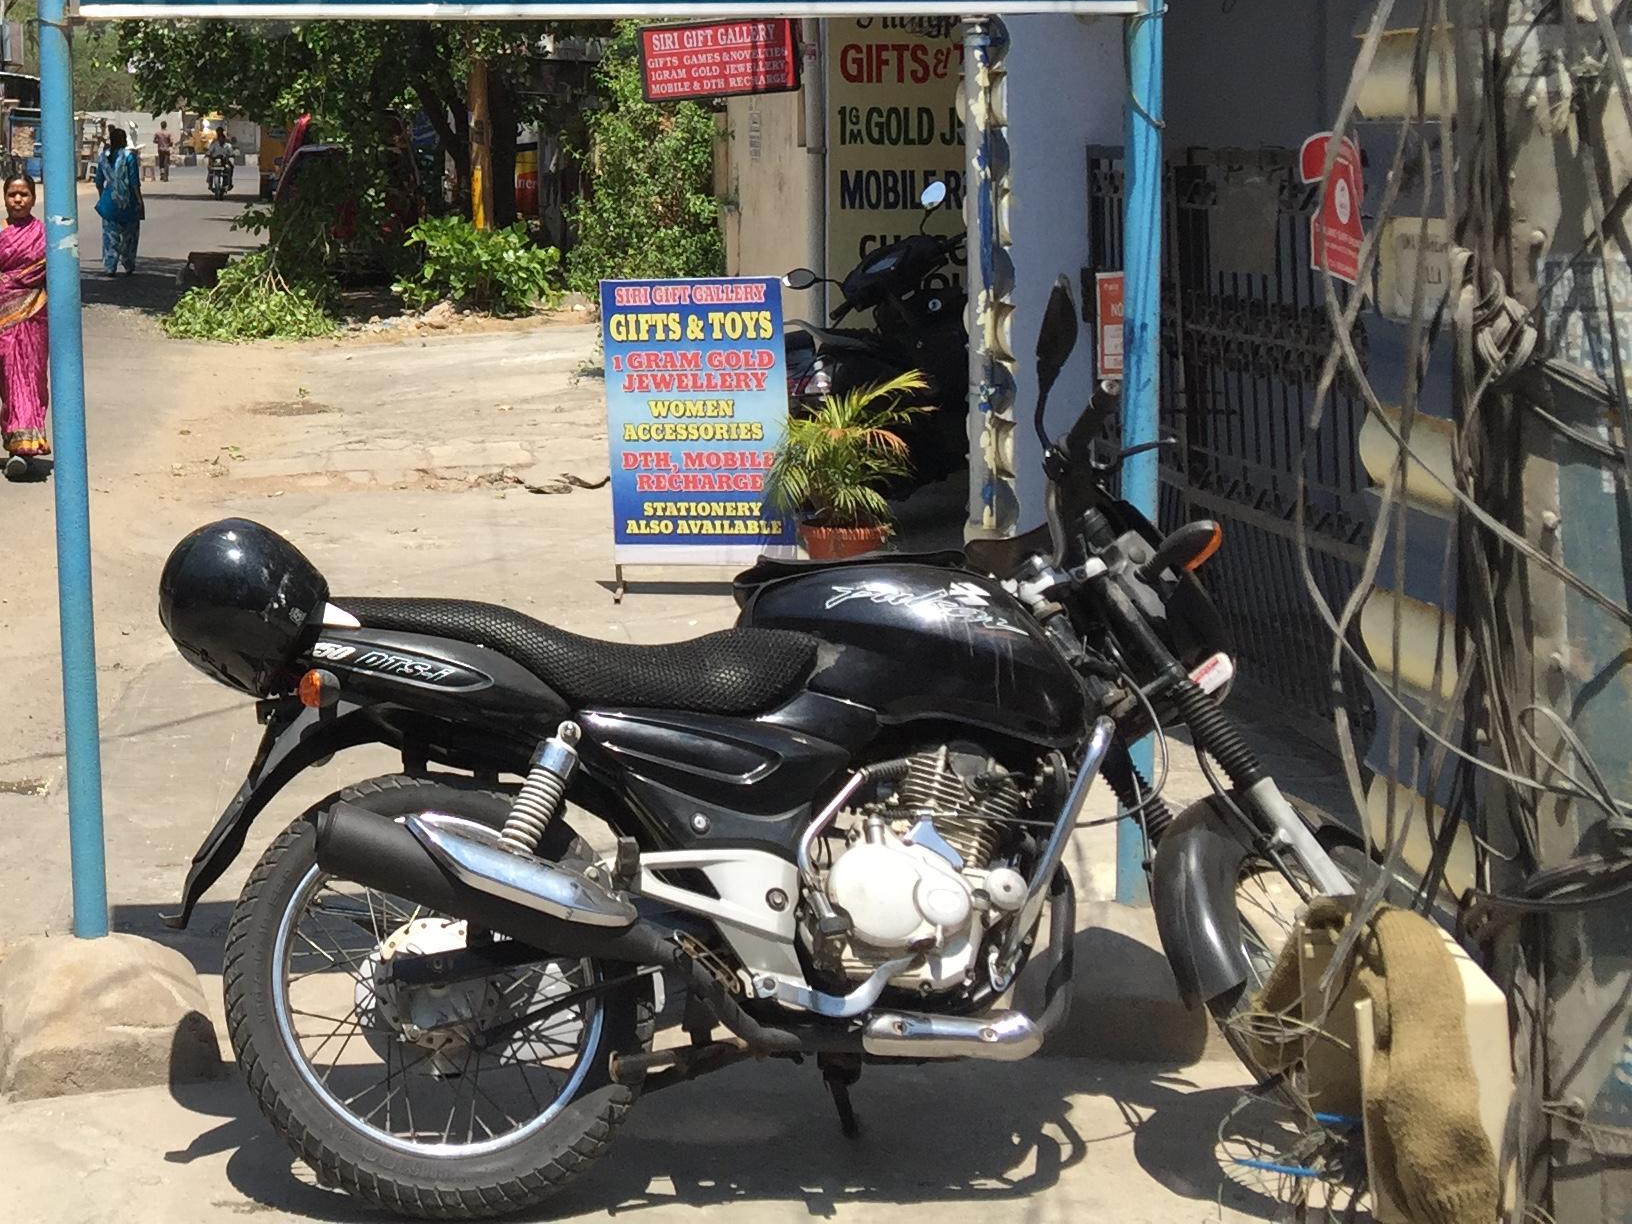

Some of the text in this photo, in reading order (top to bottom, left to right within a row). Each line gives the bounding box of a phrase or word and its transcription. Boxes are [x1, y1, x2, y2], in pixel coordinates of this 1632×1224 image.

[652, 23, 775, 51] SIRI GIFT GALLERY
[647, 57, 678, 68] GIFTS
[683, 52, 720, 66] GAMES
[691, 66, 719, 78] GOLD
[723, 60, 786, 75] JEWELLERY
[840, 43, 930, 84] GIFTS
[652, 74, 786, 94] MOBILE & DTH RECHARGE
[865, 107, 934, 145] GOLD
[615, 284, 765, 306] SIRI GIFT GALLERY
[610, 310, 773, 341] GIFTS & TOYS
[627, 351, 701, 371] GRAM
[707, 349, 775, 369] GOLD
[623, 372, 767, 393] JEWELLERY
[648, 400, 734, 418] WOMEN
[624, 423, 764, 441] ACCESSORIES
[622, 451, 775, 473] DTH, MOBILE
[637, 474, 764, 492] RECHARGE
[643, 501, 762, 517] STATIONERY
[626, 519, 782, 536] ALSO AVAILABLE
